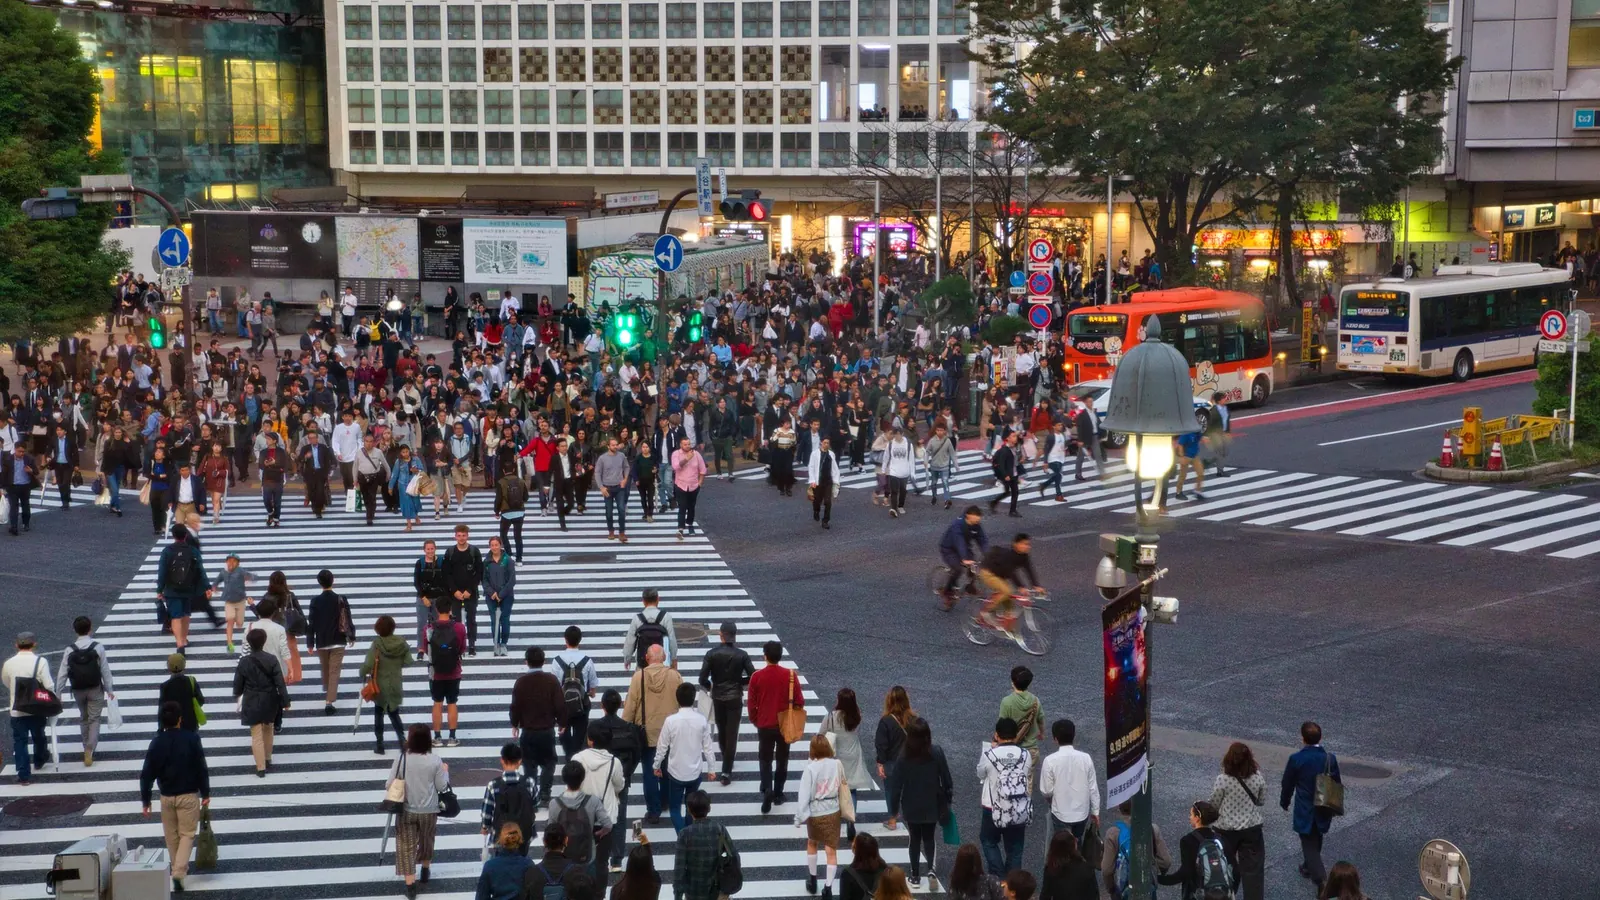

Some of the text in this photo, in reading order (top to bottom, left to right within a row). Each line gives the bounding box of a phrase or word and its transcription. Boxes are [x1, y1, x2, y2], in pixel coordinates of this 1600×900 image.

[701, 162, 712, 213] 渋谷駅前
[1540, 342, 1564, 351] ここまで
